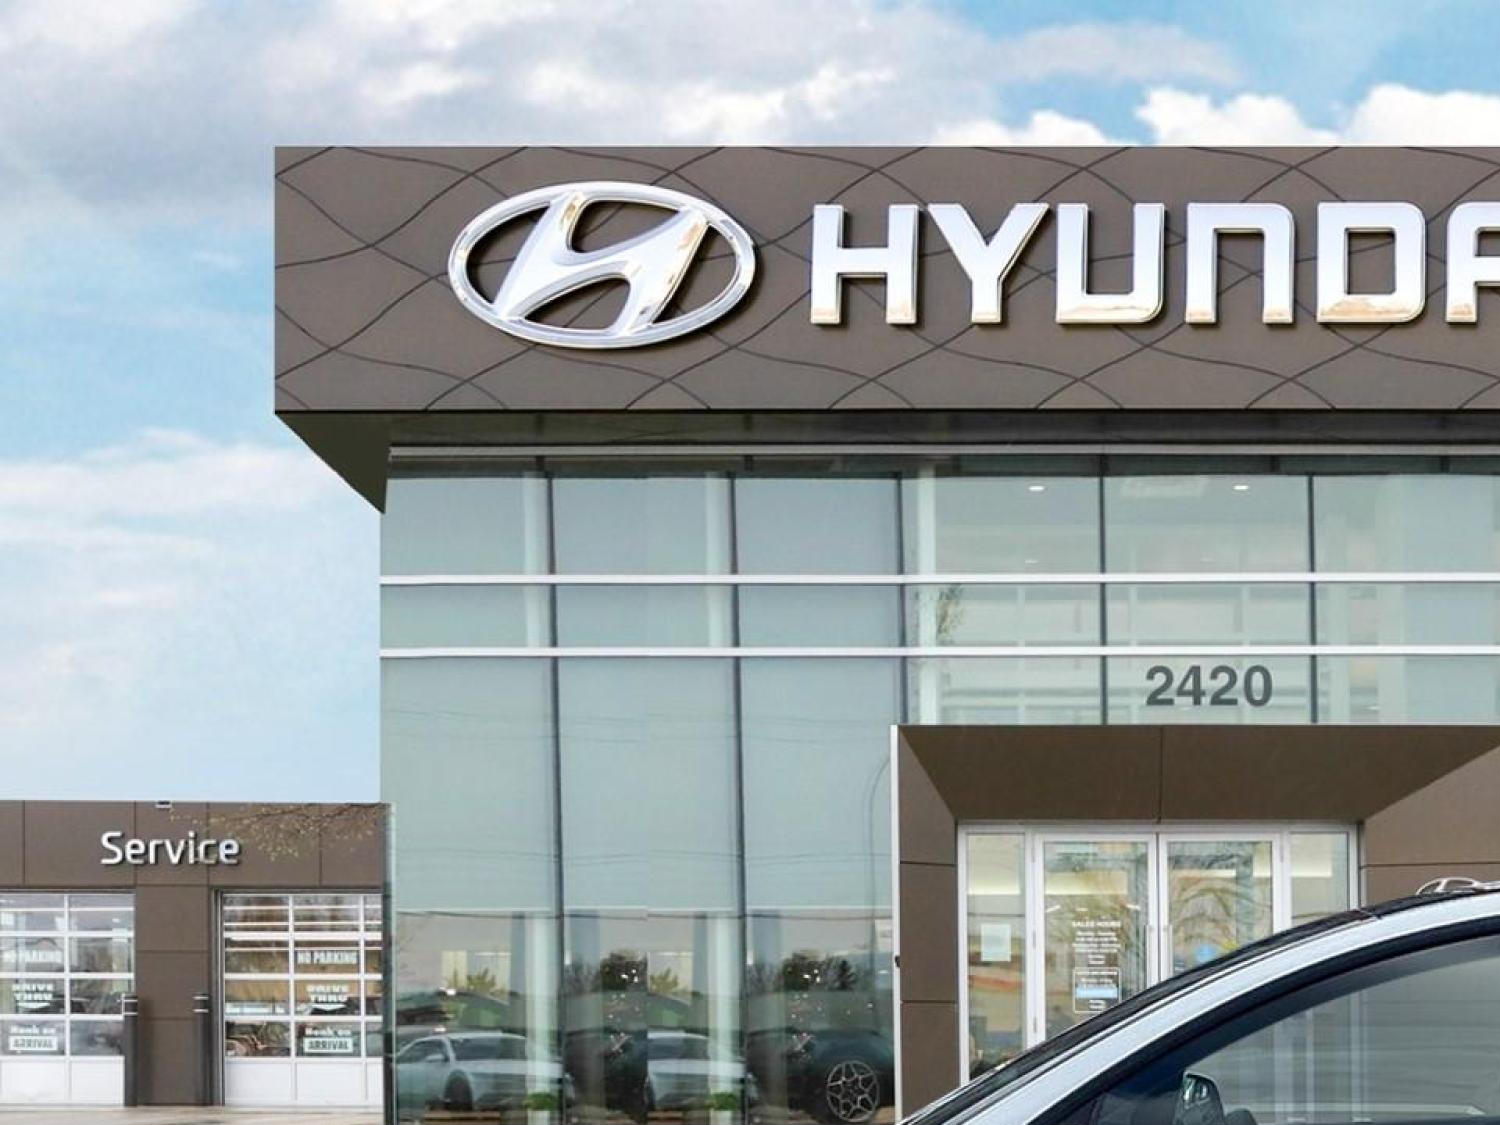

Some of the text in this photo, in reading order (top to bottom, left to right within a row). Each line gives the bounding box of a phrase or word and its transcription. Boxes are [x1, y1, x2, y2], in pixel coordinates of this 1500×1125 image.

[1145, 664, 1273, 707] 2420
[100, 830, 241, 865] Service
[313, 951, 358, 965] PARKING
[308, 1040, 349, 1050] ARRIVAL
